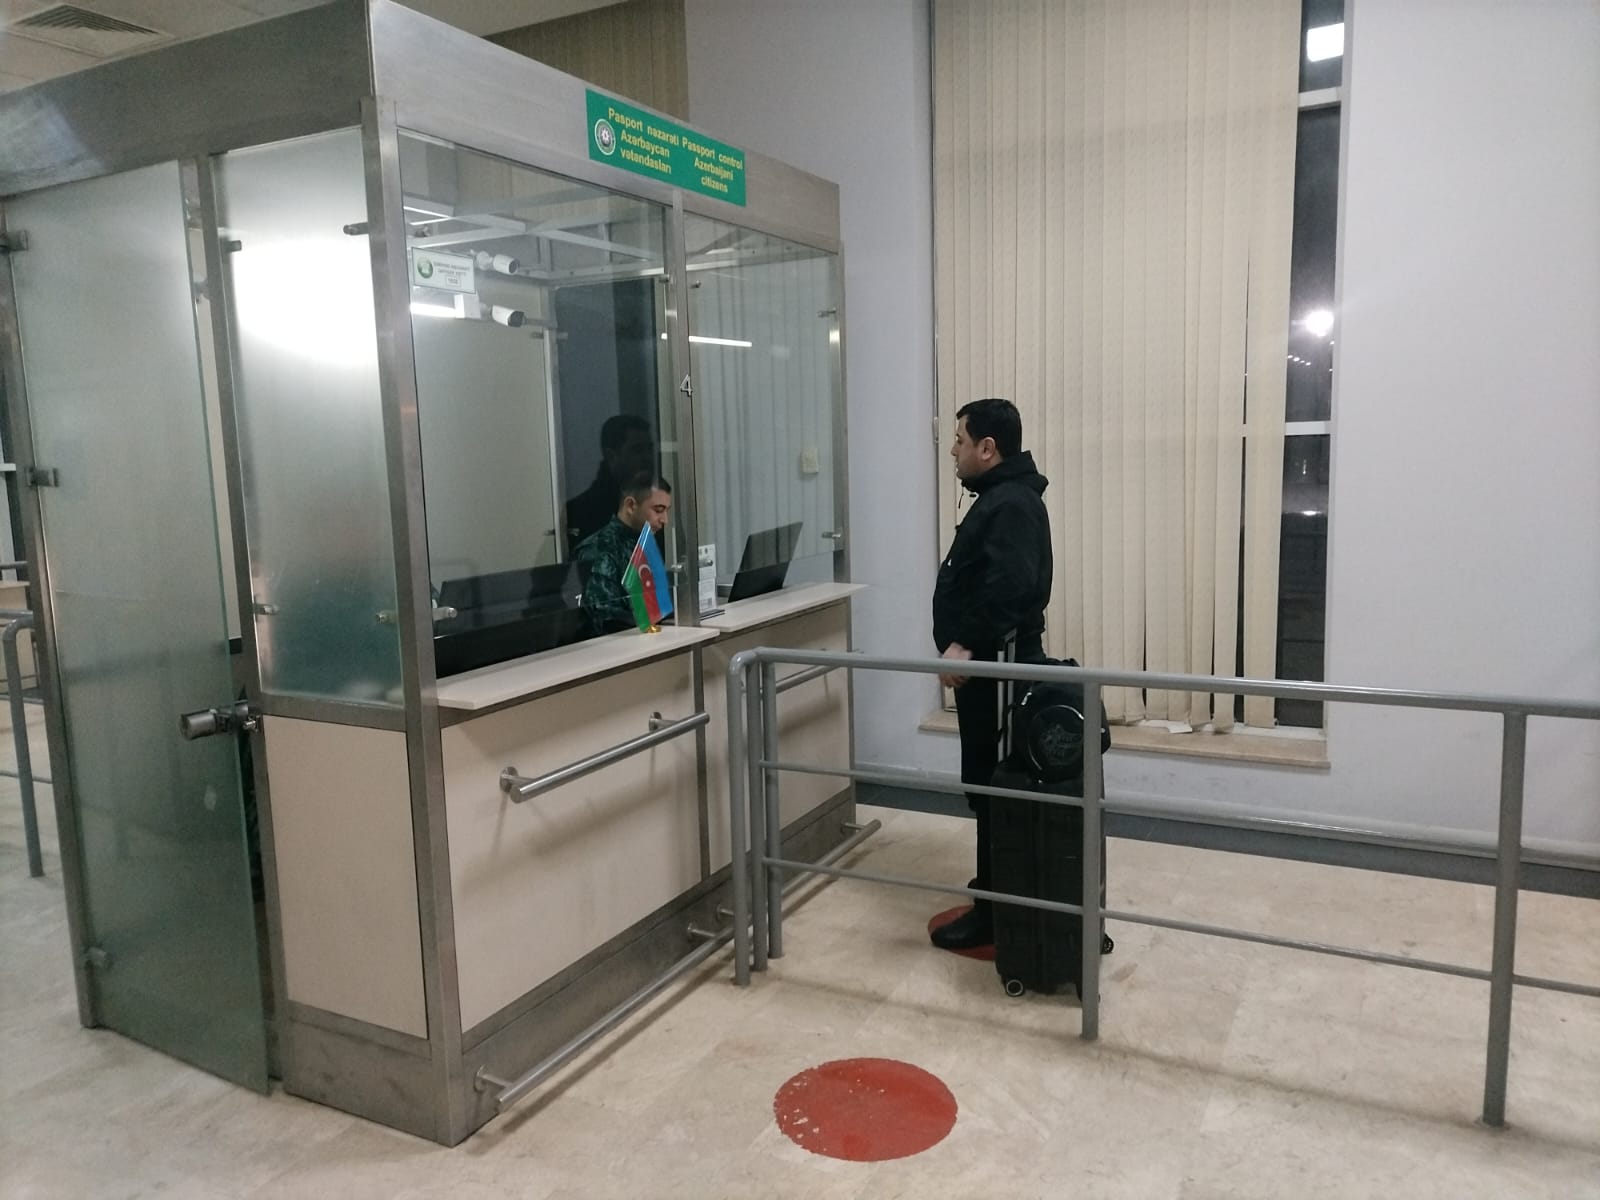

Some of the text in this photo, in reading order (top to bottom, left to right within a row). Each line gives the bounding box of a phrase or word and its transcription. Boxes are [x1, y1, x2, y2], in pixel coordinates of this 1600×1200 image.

[608, 107, 643, 132] Pasport
[682, 136, 743, 170] Passport control
[694, 156, 733, 181] Azerbaijani
[701, 175, 728, 193] citizens
[680, 374, 693, 397] 4
